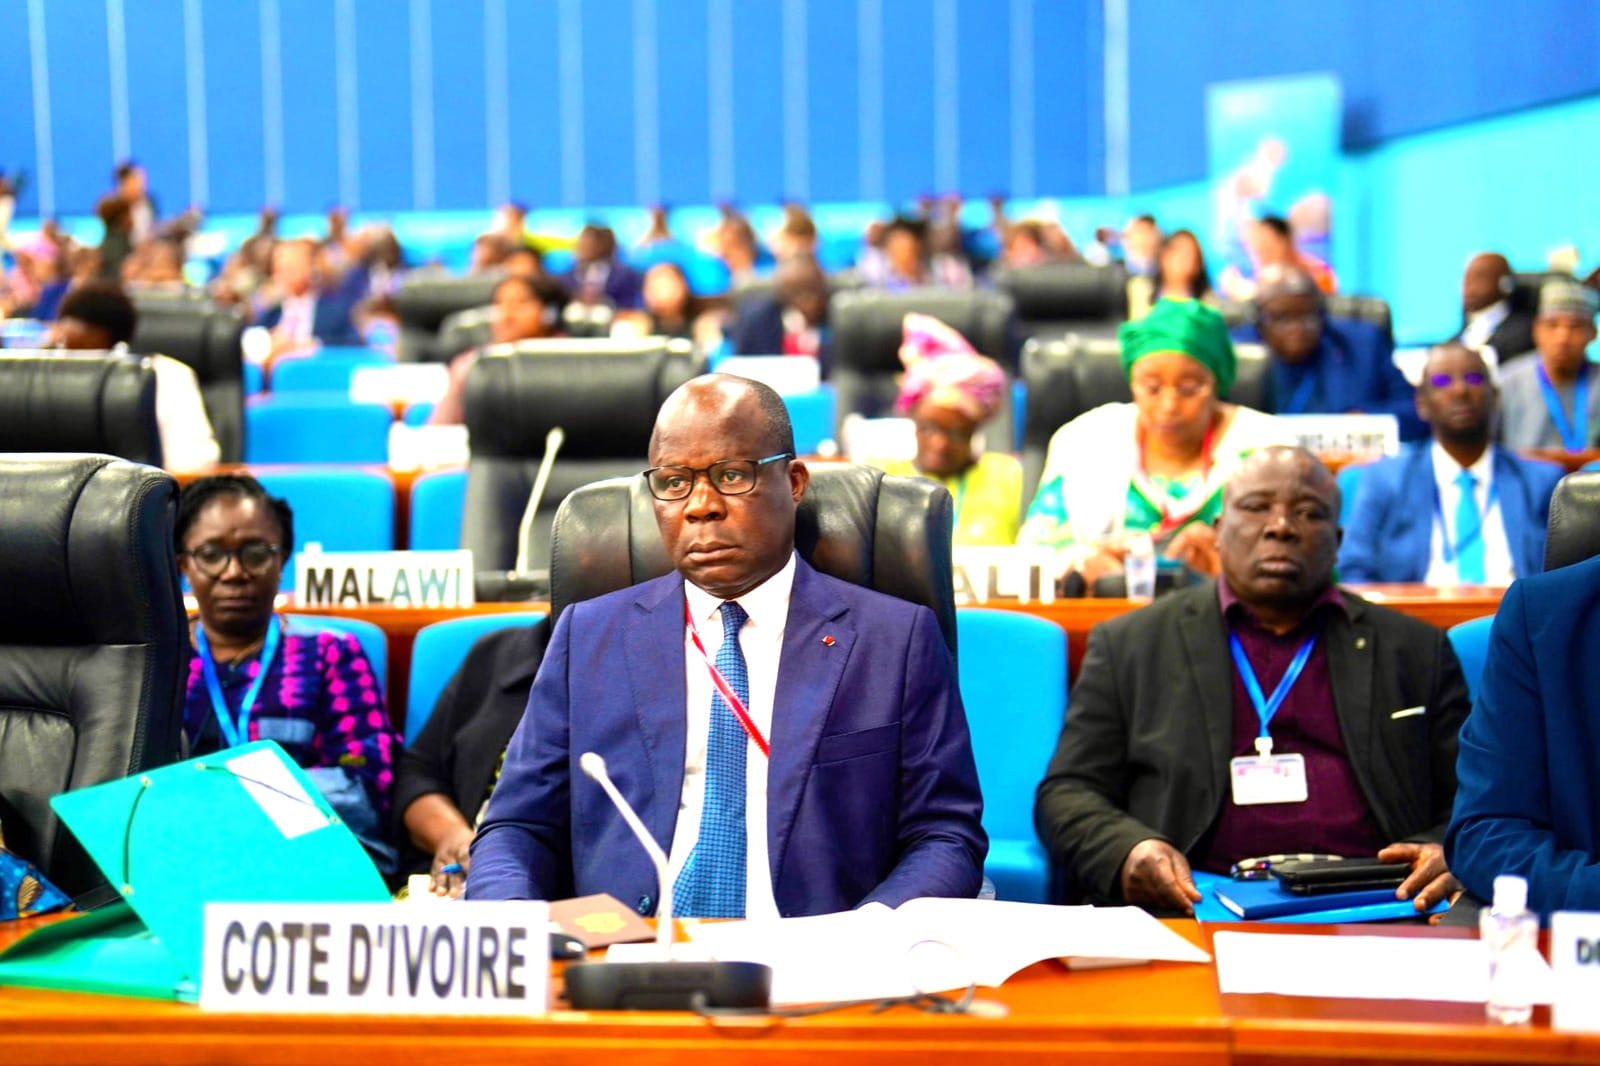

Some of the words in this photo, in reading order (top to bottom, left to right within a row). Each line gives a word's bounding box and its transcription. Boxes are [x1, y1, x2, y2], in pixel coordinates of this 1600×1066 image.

[306, 567, 460, 603] MALAWI
[221, 920, 330, 995] COTE
[347, 923, 527, 999] D'IVOIRE
[1576, 937, 1600, 967] D
